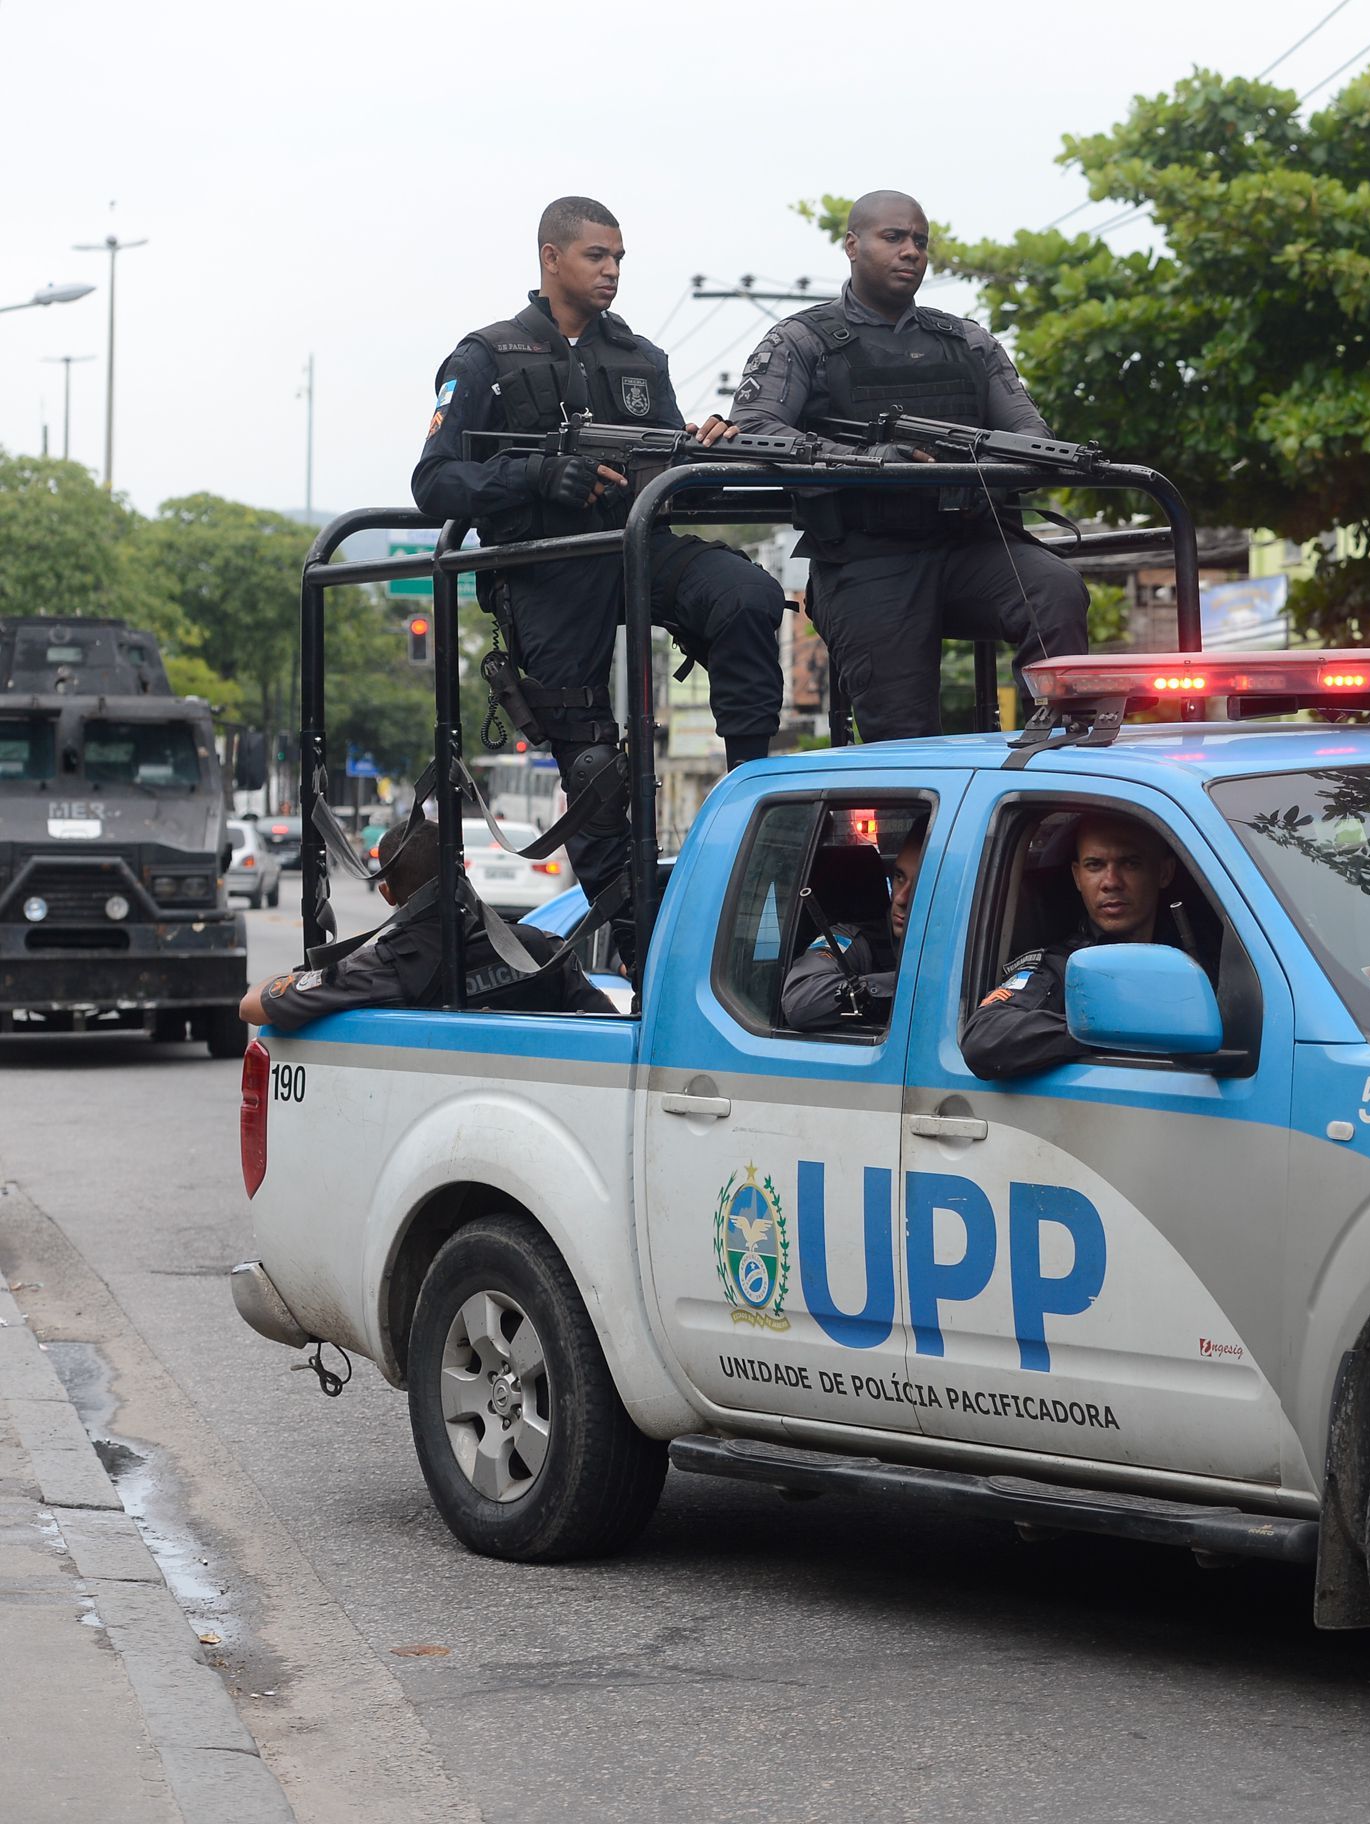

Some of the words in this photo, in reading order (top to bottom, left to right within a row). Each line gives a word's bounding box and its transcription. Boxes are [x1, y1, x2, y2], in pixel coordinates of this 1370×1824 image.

[508, 343, 532, 351] PAULA
[271, 1064, 306, 1102] 190
[797, 1160, 1107, 1373] UPP
[719, 1355, 812, 1389] UNIDADE
[818, 1371, 848, 1395] DE
[850, 1372, 943, 1408] POLÍCIA
[945, 1387, 1121, 1430] PACIFICADORA
